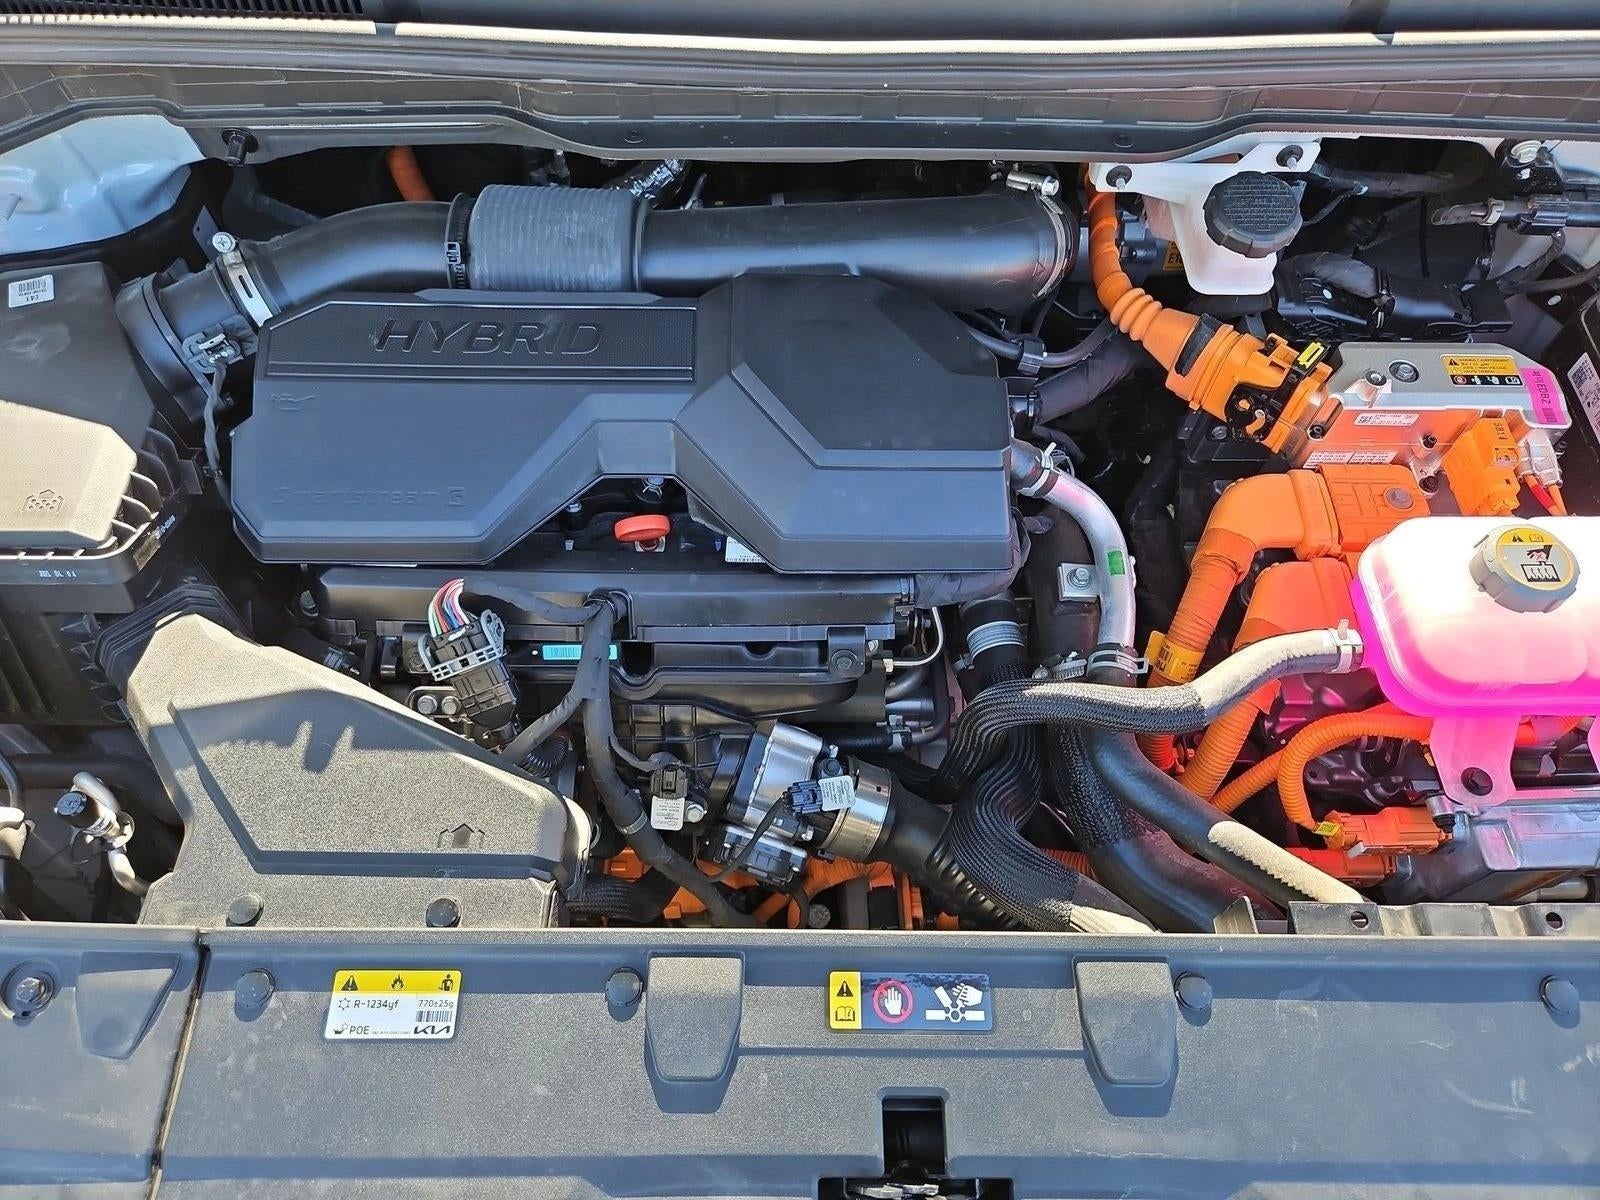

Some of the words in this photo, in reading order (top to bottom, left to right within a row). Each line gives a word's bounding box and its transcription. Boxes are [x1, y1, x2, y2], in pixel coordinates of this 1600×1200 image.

[373, 319, 602, 355] HYBRID
[353, 999, 400, 1010] R-1234yf
[418, 999, 454, 1009] 770±25g
[349, 1025, 371, 1035] POE
